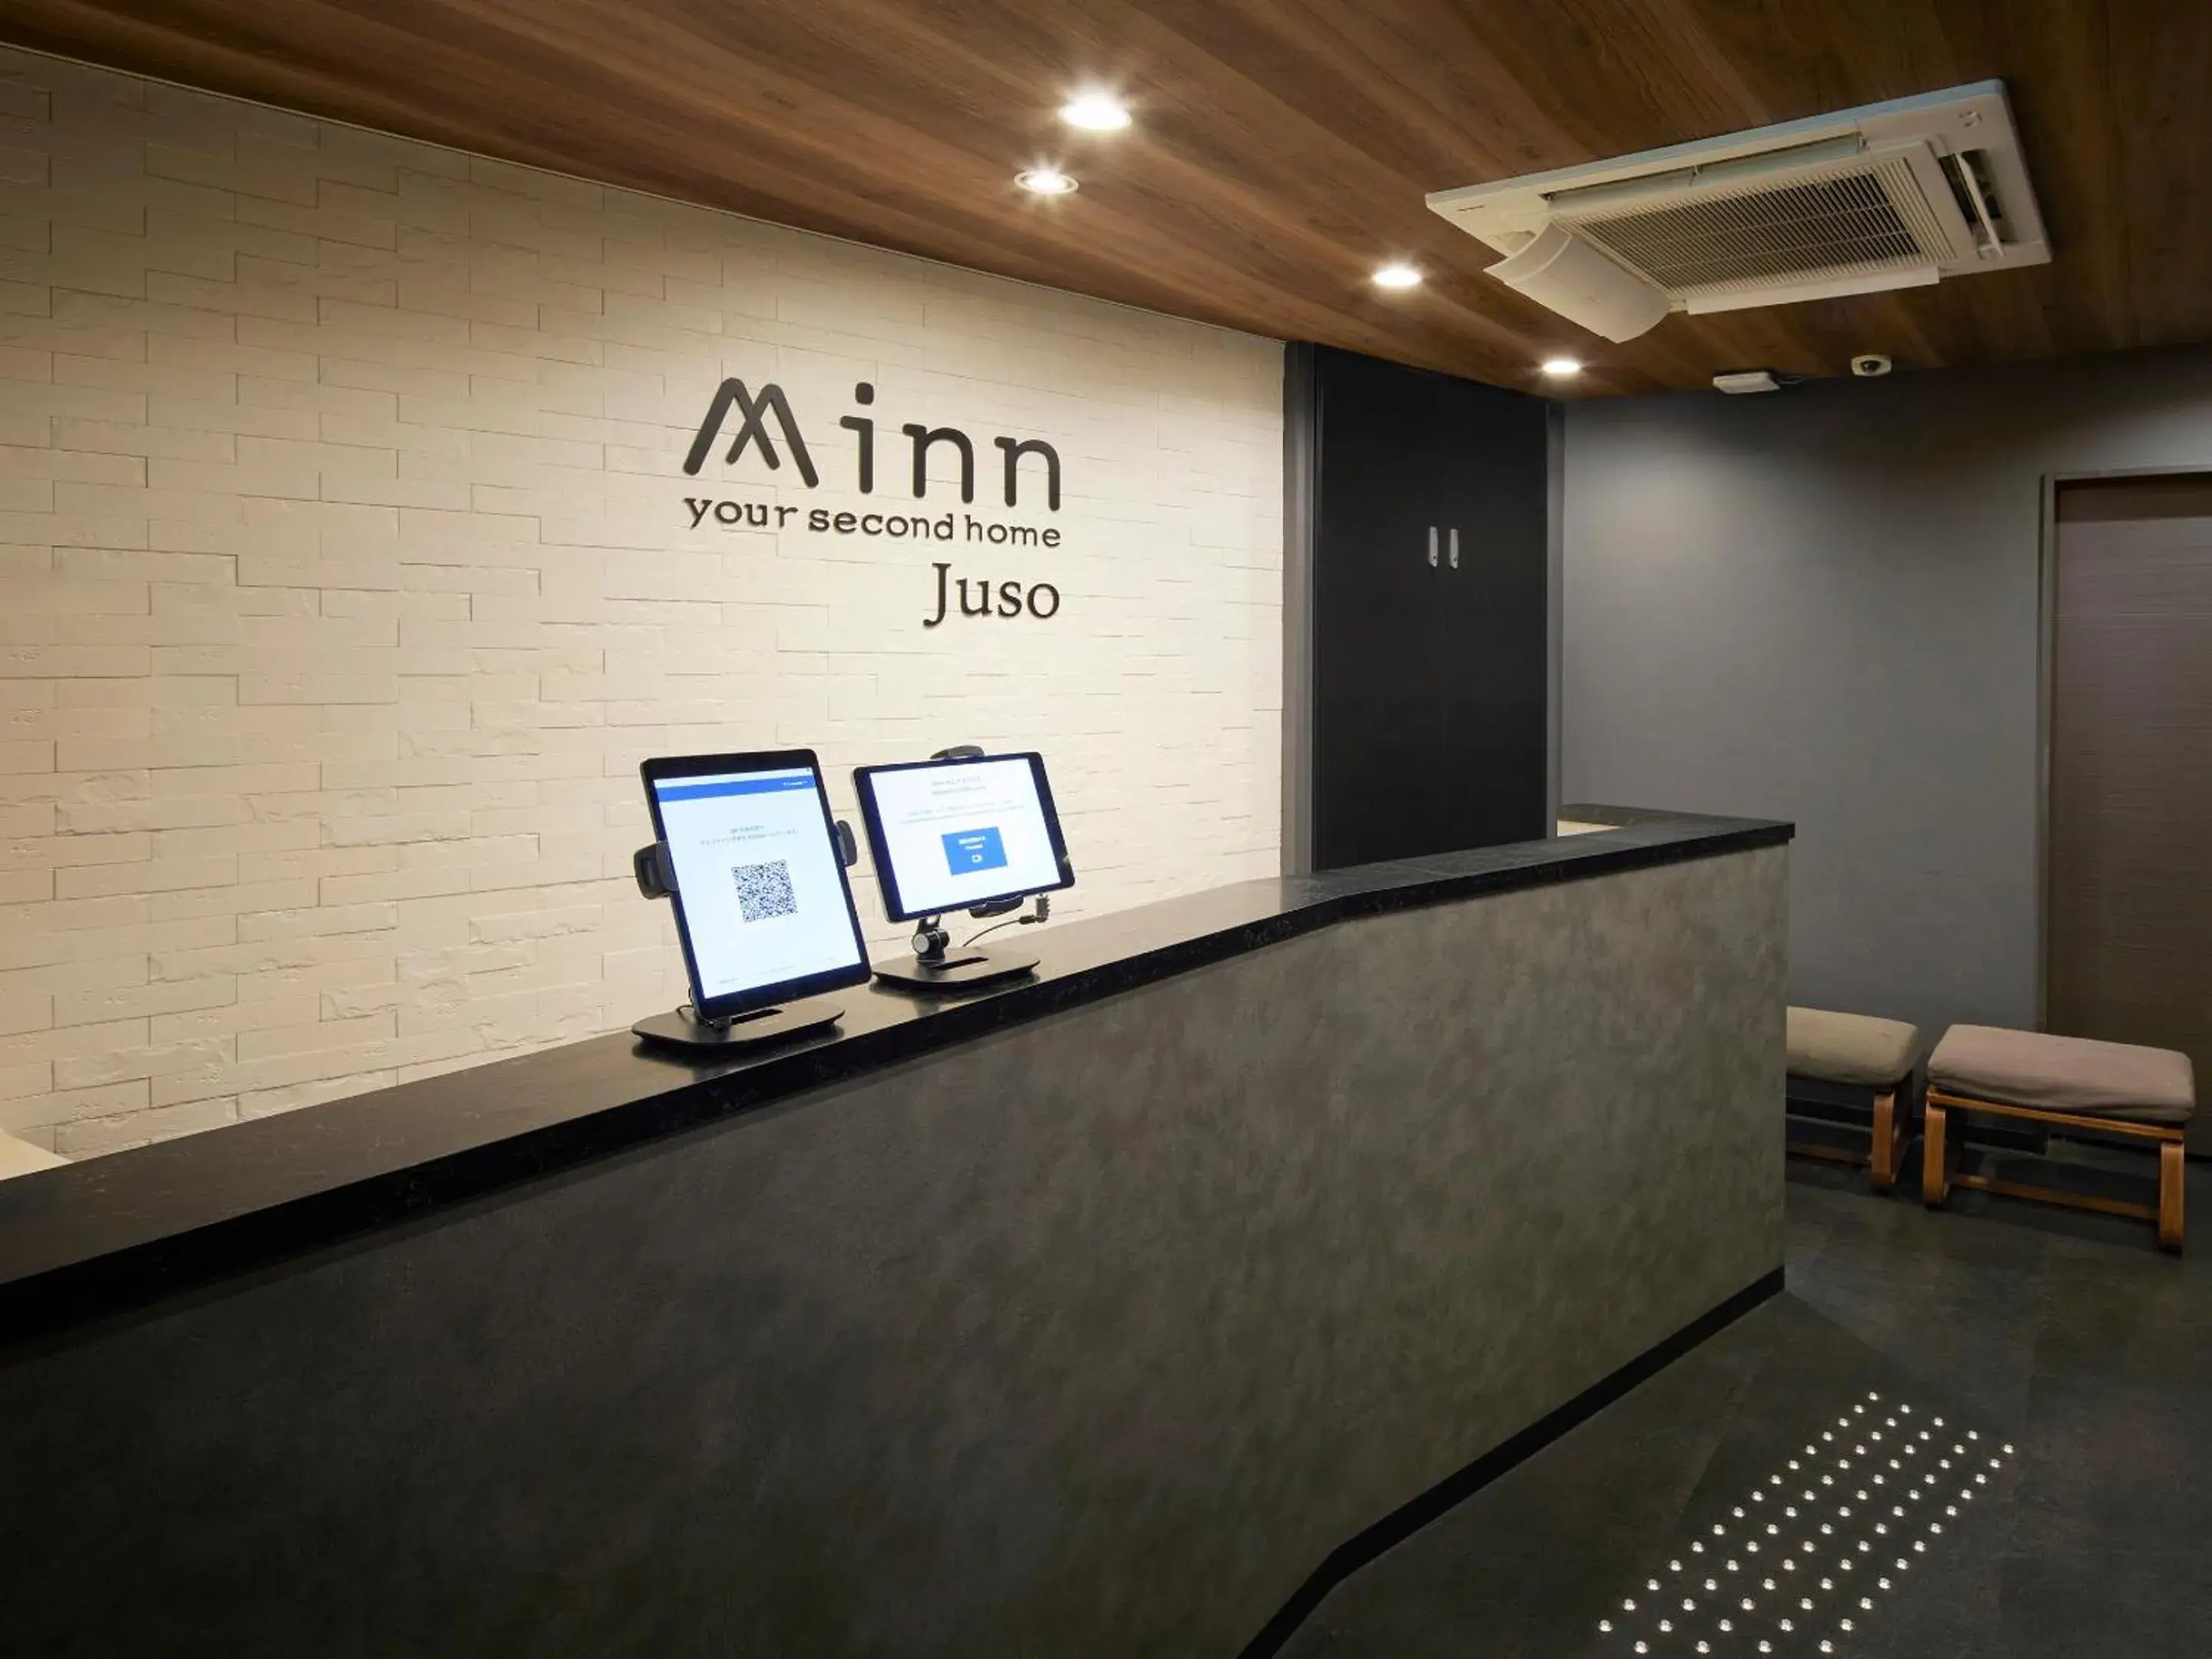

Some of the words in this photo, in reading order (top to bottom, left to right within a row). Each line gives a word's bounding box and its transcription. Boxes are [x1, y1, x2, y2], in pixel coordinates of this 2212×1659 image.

[683, 377, 1061, 512] Minn
[683, 497, 799, 529] your
[808, 508, 954, 540] second
[965, 514, 1061, 548] home
[922, 562, 1061, 628] Juso
